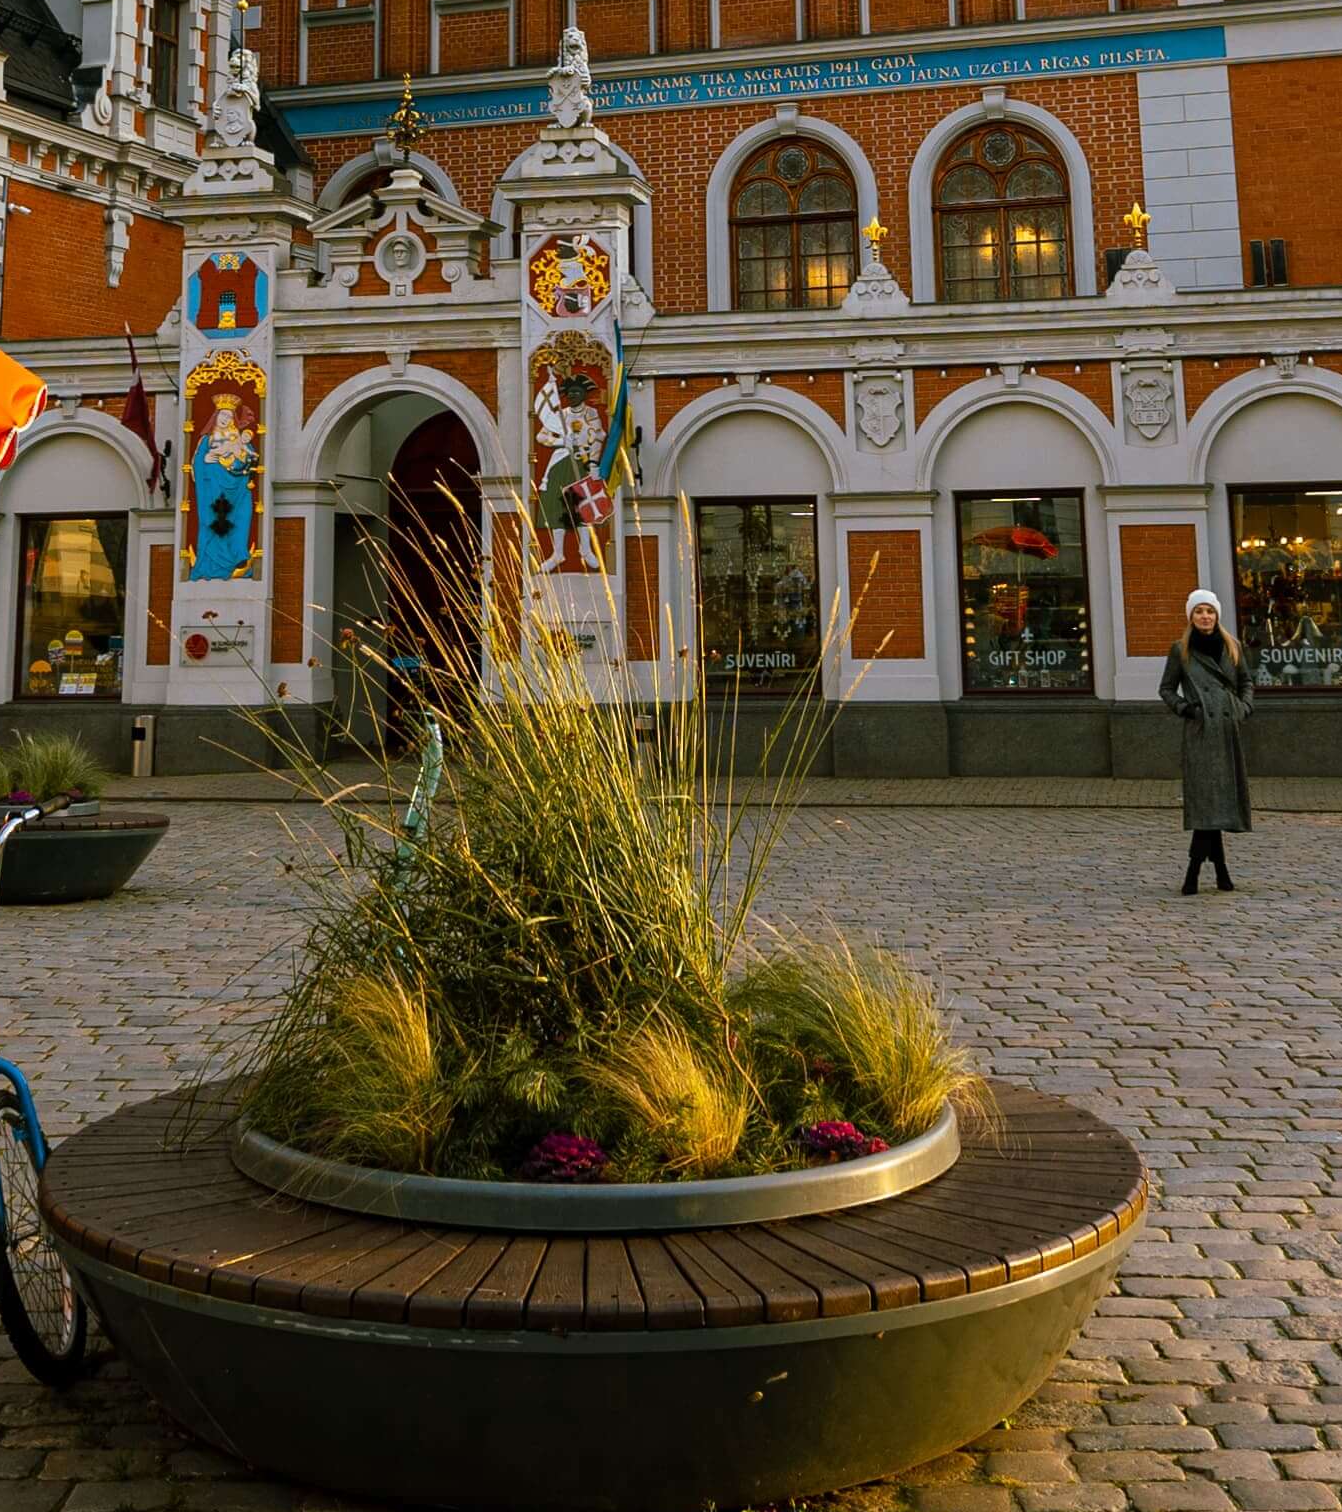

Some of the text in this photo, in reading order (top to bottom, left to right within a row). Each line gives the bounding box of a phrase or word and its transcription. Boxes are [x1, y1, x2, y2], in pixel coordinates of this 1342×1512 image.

[624, 90, 670, 106] NAMU
[678, 88, 699, 102] UZ
[790, 73, 869, 93] PAMATIEM
[877, 70, 901, 85] NO
[910, 65, 961, 83] JAUNA
[650, 75, 692, 90] NAMS
[699, 71, 736, 86] TIKA
[743, 63, 821, 81] SAGRAUTS
[725, 650, 796, 669] SUVENĪRI
[988, 649, 1067, 666] GIFT SHOP
